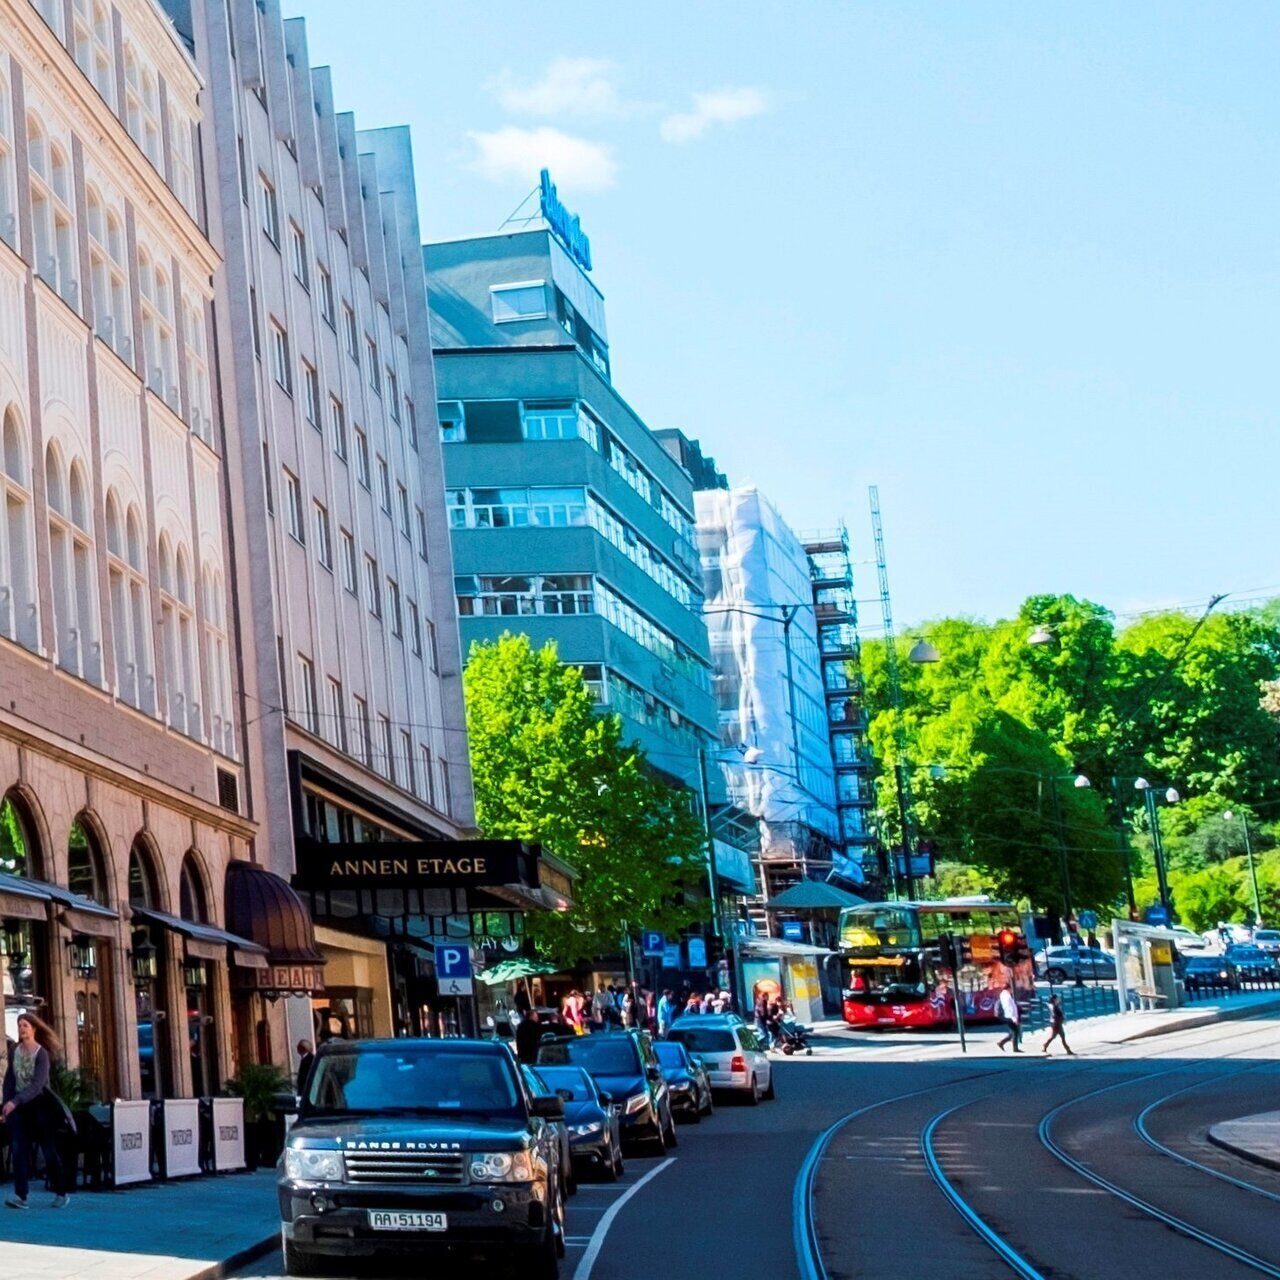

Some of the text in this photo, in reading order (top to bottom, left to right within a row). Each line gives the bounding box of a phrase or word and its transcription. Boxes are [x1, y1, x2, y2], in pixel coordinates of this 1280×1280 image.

[329, 858, 487, 876] ANNEN ETAGE
[649, 934, 659, 949] P
[443, 949, 461, 974] P
[346, 1141, 400, 1149] RANGE
[374, 1213, 443, 1227] AA 51194
